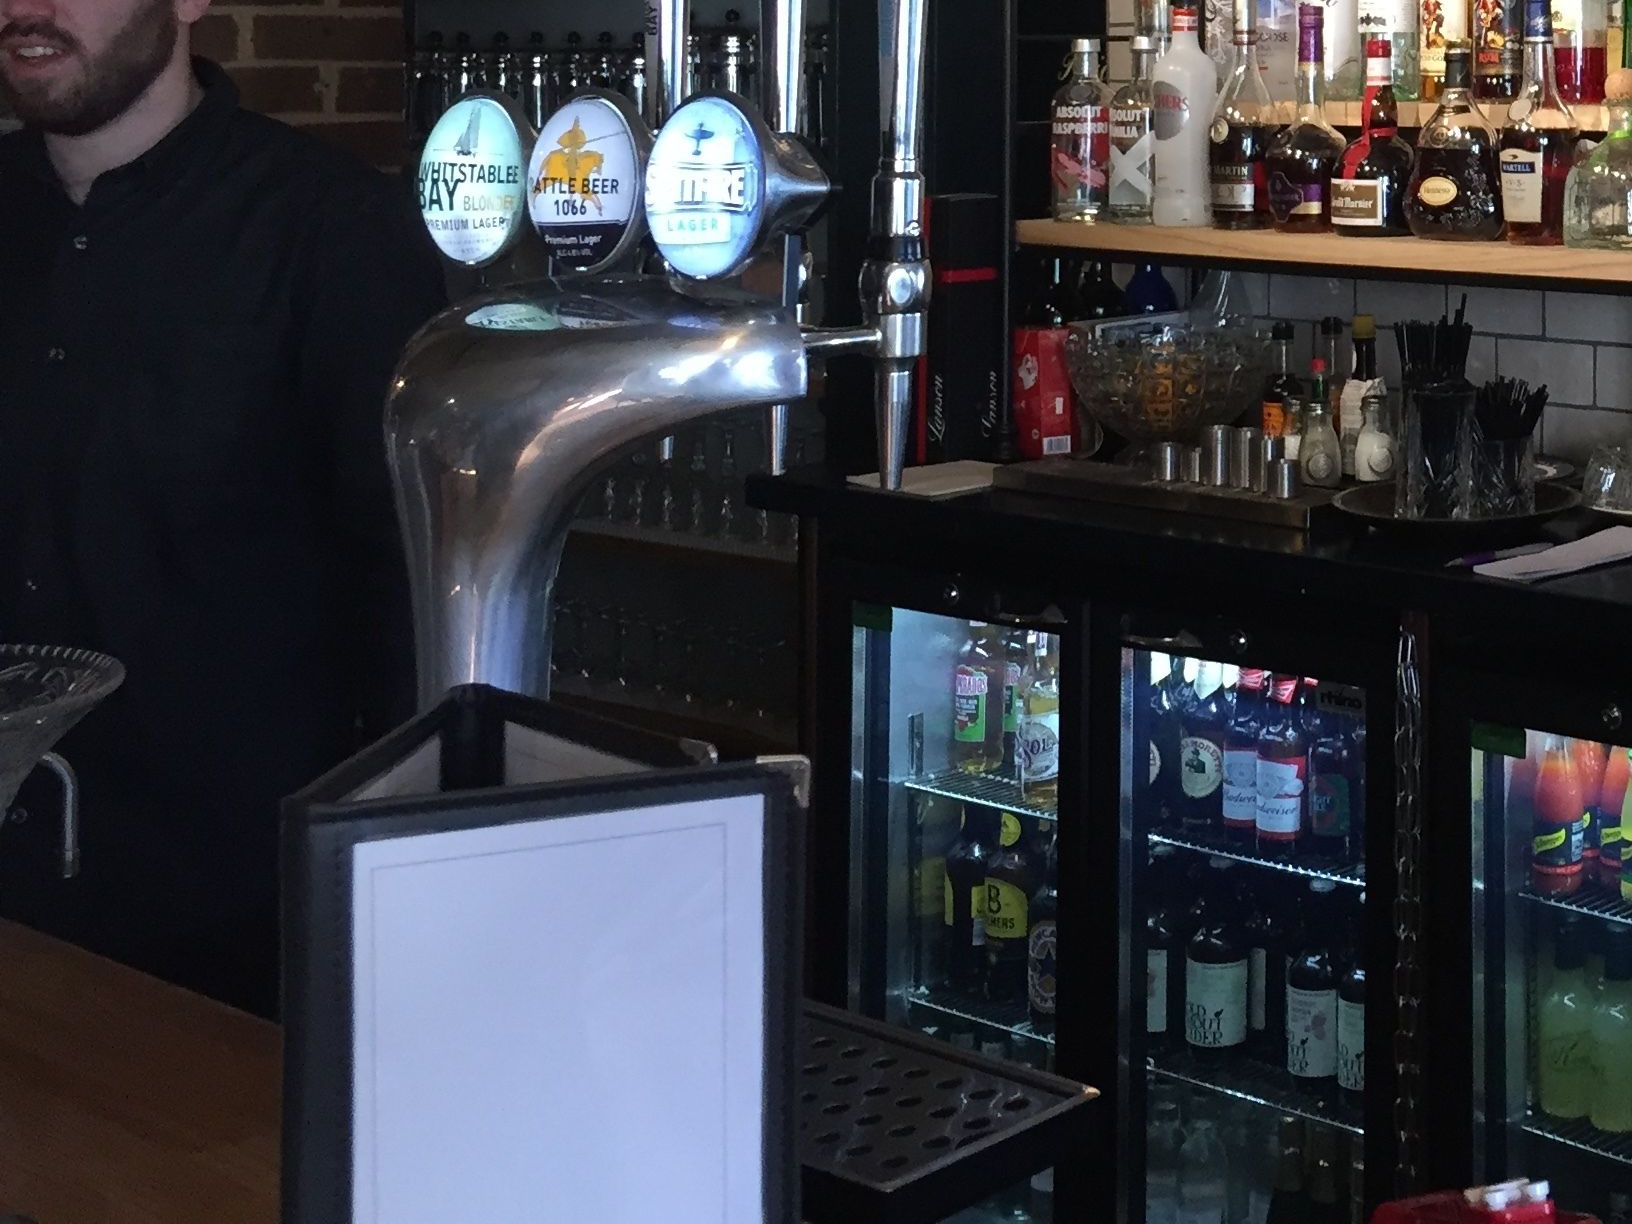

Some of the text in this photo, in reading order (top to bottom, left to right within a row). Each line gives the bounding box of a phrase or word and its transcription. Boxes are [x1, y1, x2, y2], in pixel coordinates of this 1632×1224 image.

[1055, 105, 1103, 119] ABSOLUT
[418, 177, 455, 212] BAY
[532, 176, 620, 195] ATTLE BEER
[553, 198, 588, 216] 1066
[472, 216, 507, 230] LAGER
[667, 217, 719, 232] LAGER
[927, 372, 946, 447] Lanson
